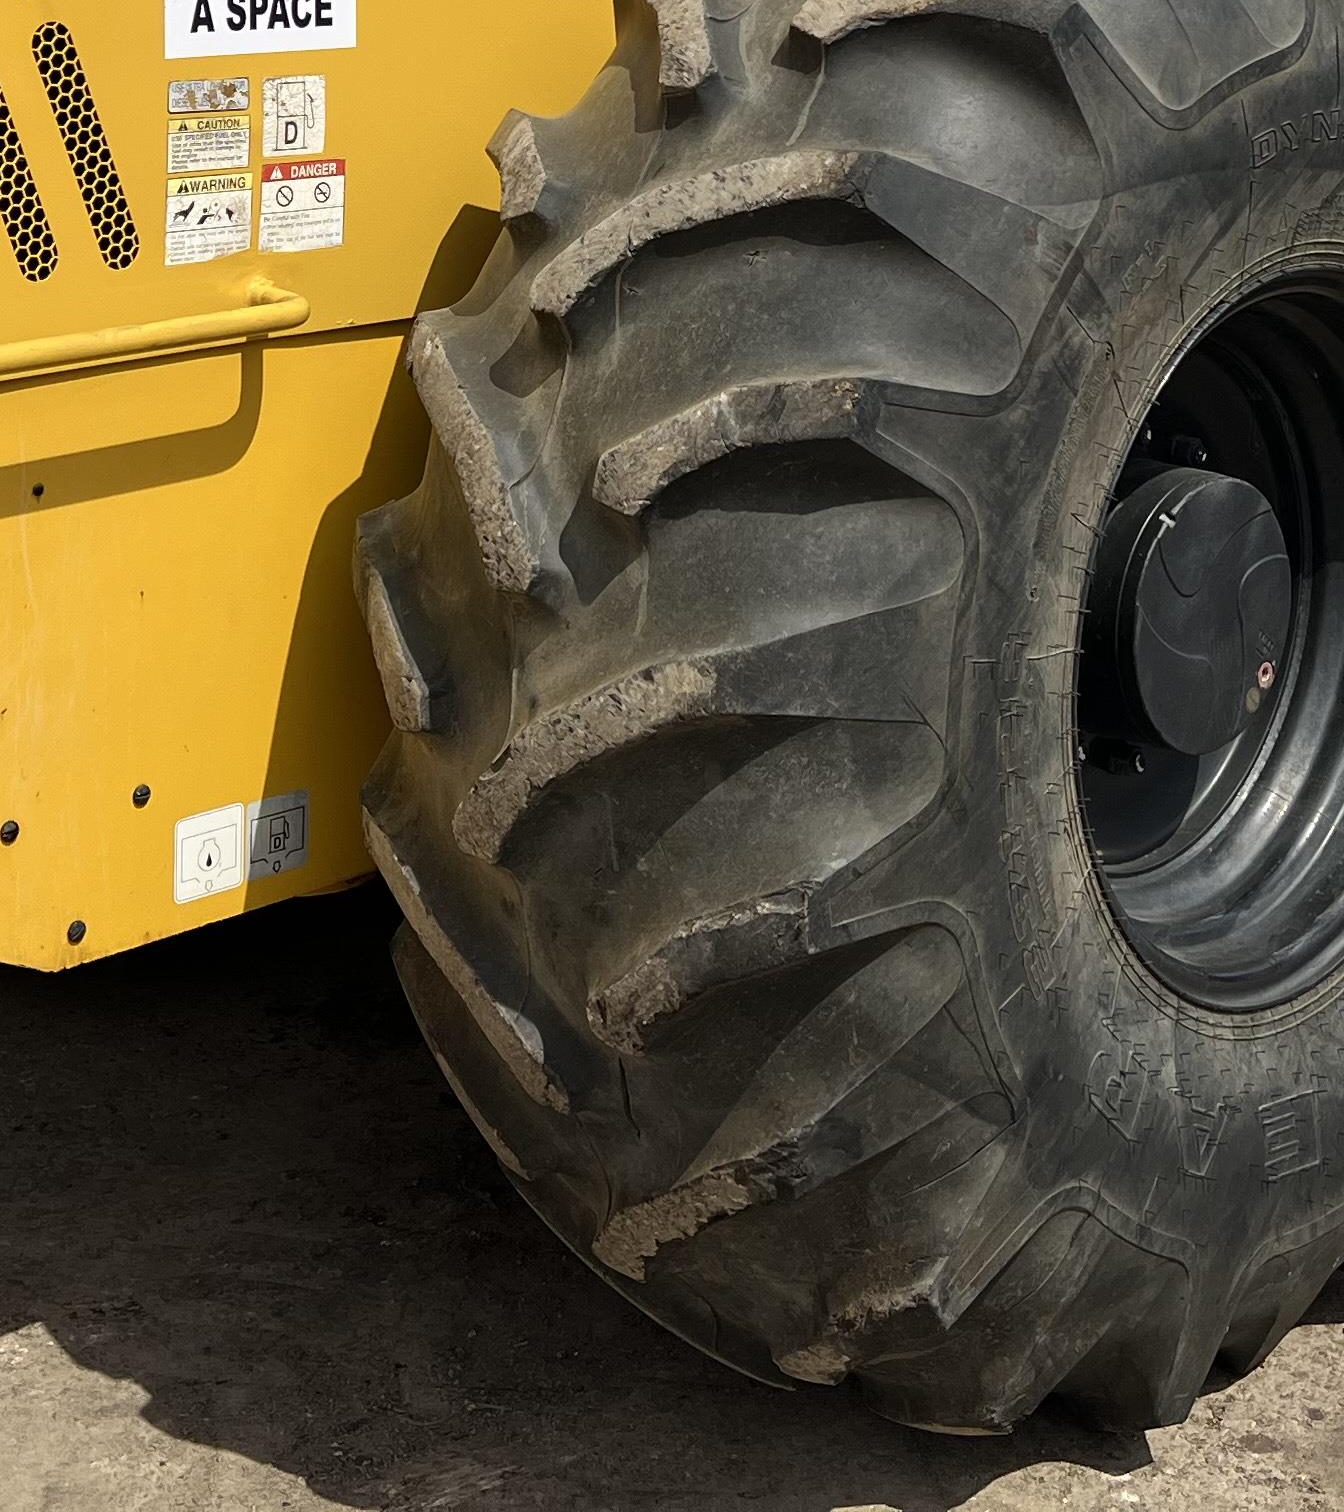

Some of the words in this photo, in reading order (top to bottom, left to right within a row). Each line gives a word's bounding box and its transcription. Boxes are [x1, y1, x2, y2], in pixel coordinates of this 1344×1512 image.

[197, 118, 241, 131] CAUTION
[290, 162, 337, 178] DANGER
[189, 176, 246, 193] WARNING
